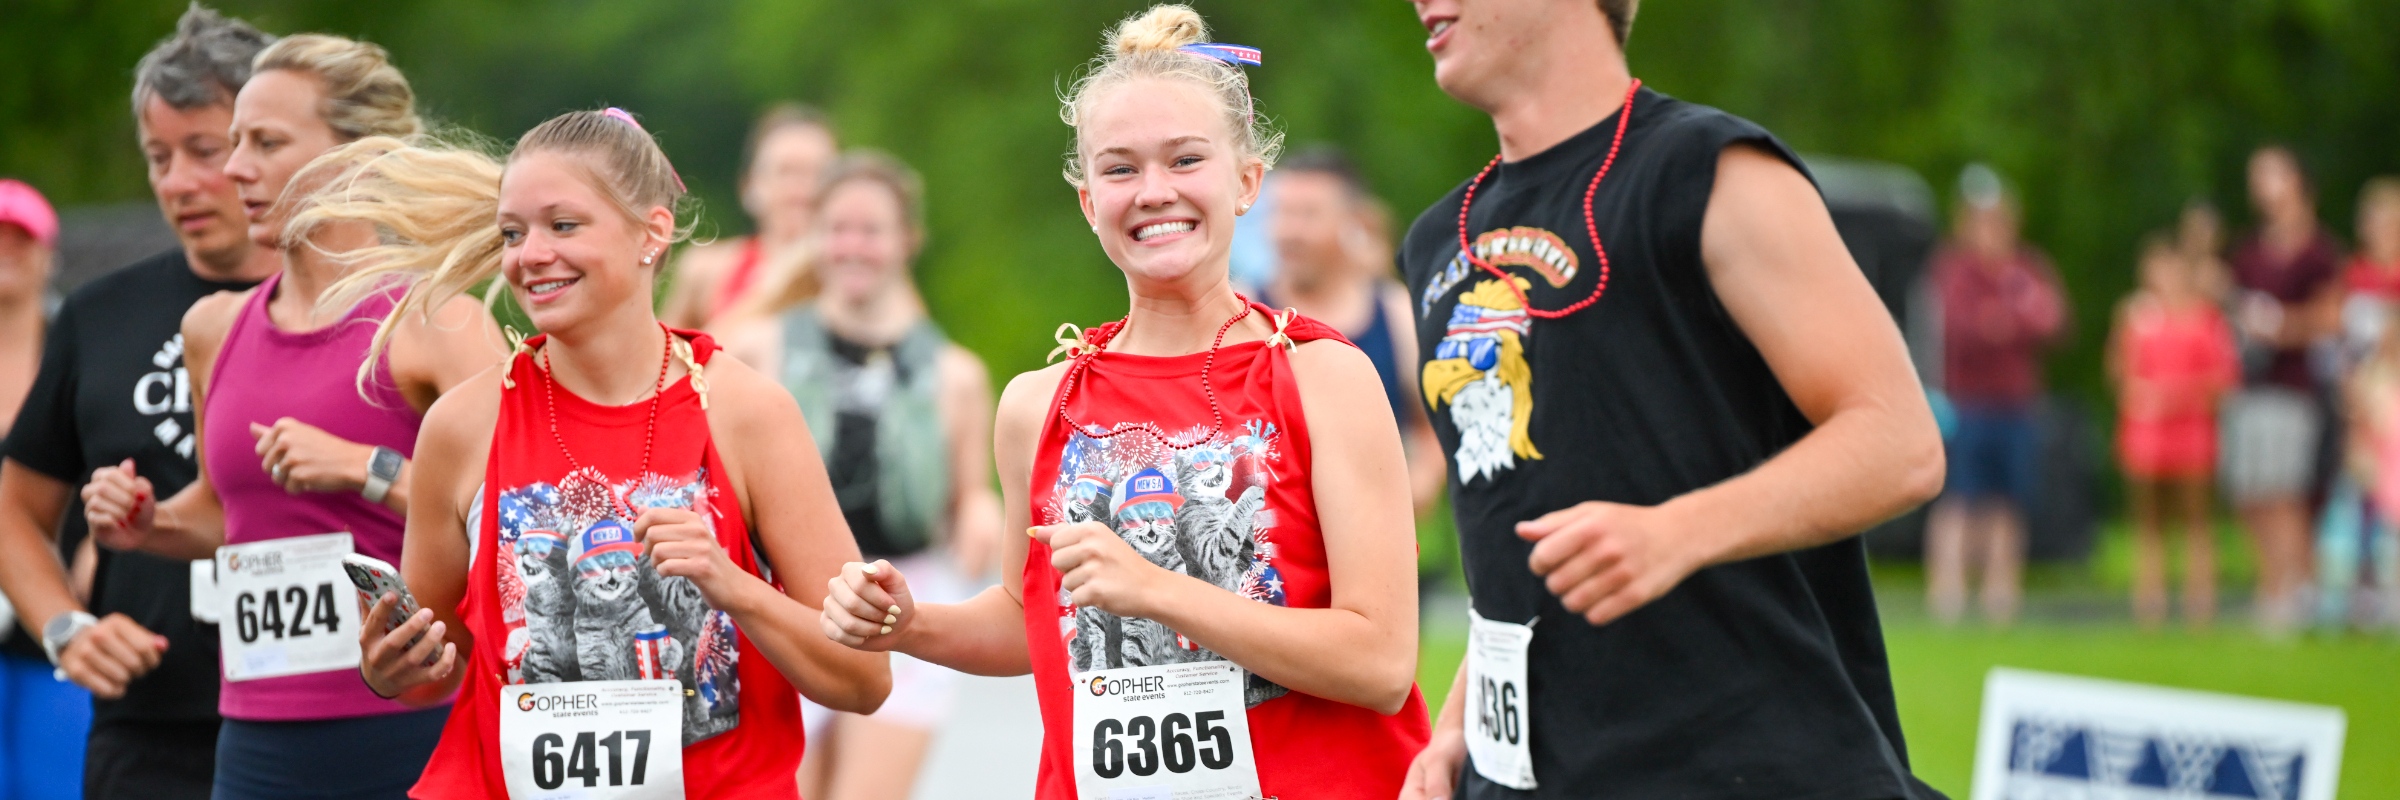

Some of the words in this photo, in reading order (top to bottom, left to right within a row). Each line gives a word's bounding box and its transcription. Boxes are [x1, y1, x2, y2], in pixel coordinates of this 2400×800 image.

[236, 583, 341, 644] 6424
[1090, 676, 1165, 697] GOPHER
[1123, 694, 1141, 702] state
[1142, 692, 1166, 701] events
[517, 692, 598, 712] GOPHER
[573, 709, 599, 717] events
[1092, 710, 1234, 779] 6365
[532, 729, 651, 790] 6417
